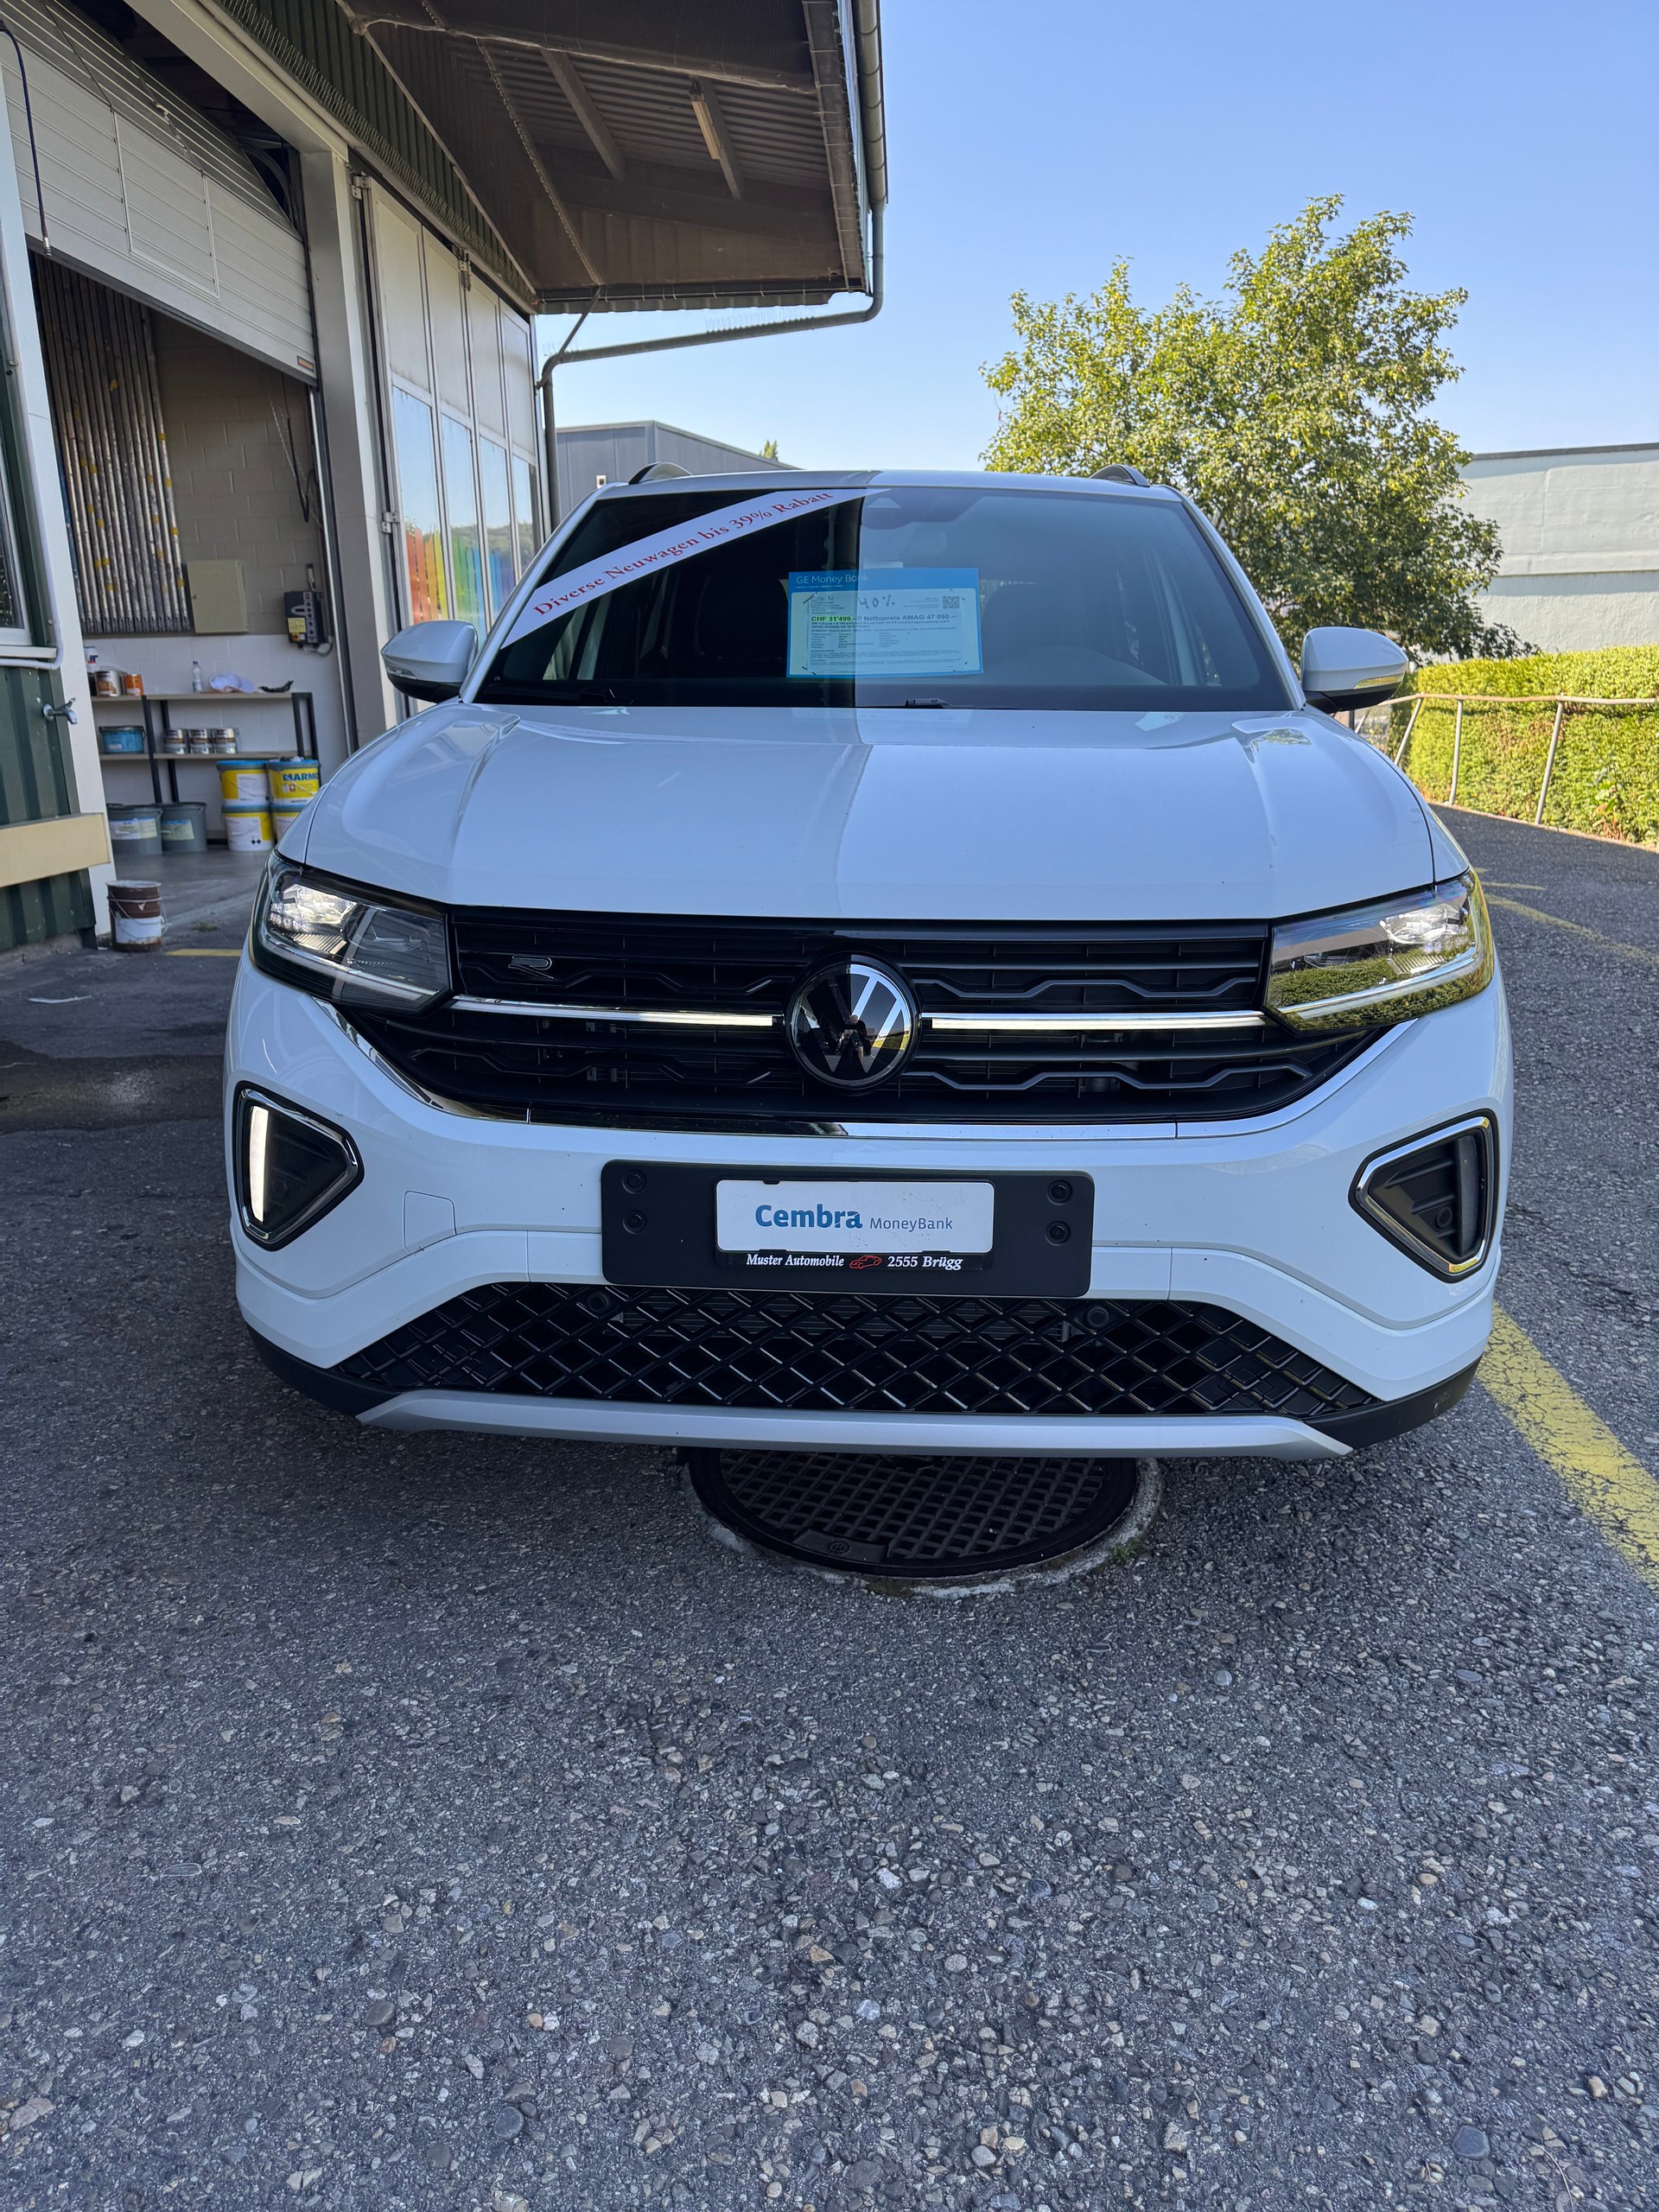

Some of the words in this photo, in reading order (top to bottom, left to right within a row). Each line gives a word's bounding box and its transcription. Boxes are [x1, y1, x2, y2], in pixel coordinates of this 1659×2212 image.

[532, 578, 605, 615] Diverse
[602, 538, 701, 580] Neuwagen
[697, 526, 729, 540] bis
[728, 510, 772, 529] 39%
[771, 492, 834, 513] Rabatt
[796, 575, 810, 584] GE
[811, 575, 843, 584] Money
[754, 1204, 863, 1229] Cembra
[869, 1217, 953, 1232] MoneyBank
[746, 1253, 783, 1267] Muster
[784, 1254, 844, 1268] Automobile
[887, 1255, 918, 1268] 2555
[921, 1255, 963, 1270] Brügg
